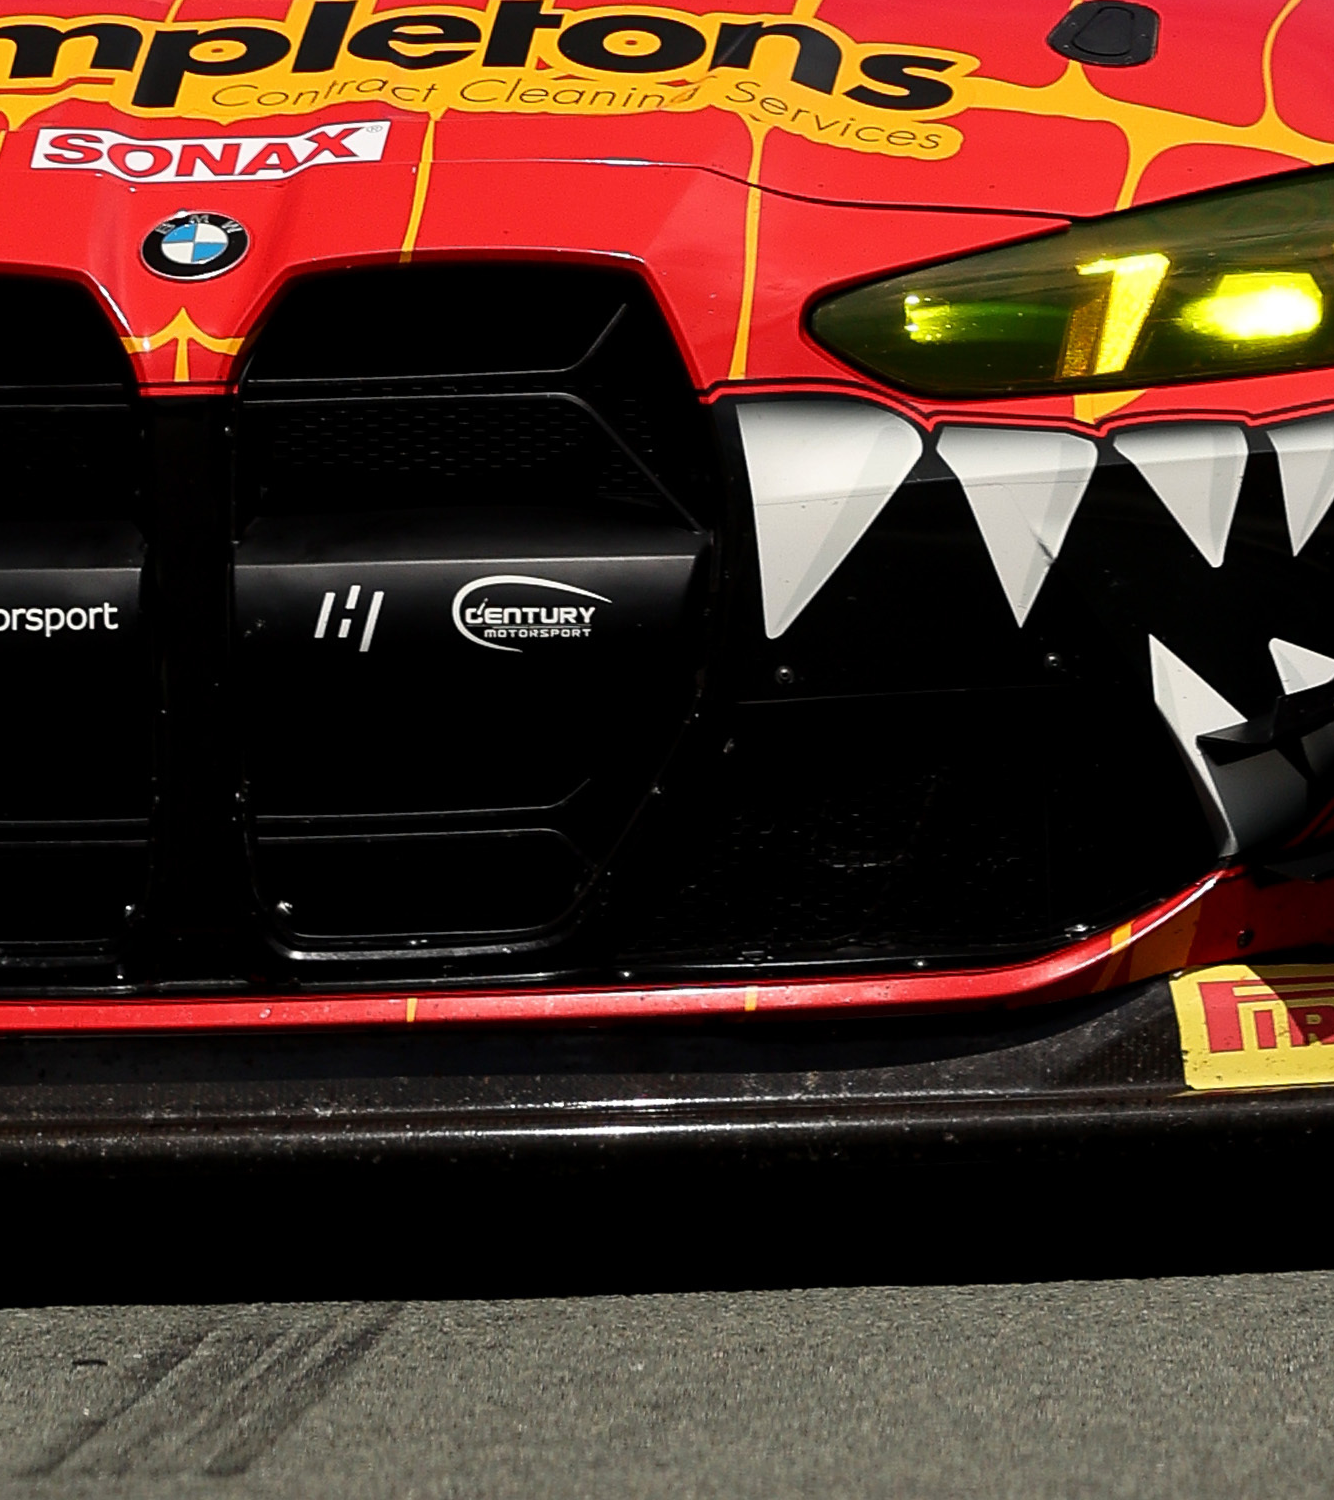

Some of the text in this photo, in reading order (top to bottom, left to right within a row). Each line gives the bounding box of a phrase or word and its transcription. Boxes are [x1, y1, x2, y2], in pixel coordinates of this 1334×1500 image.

[212, 78, 440, 106] Contract
[725, 81, 943, 149] Services
[43, 126, 367, 178] SONAX
[465, 606, 596, 624] CENTURY
[484, 628, 592, 638] MOTORSPORT
